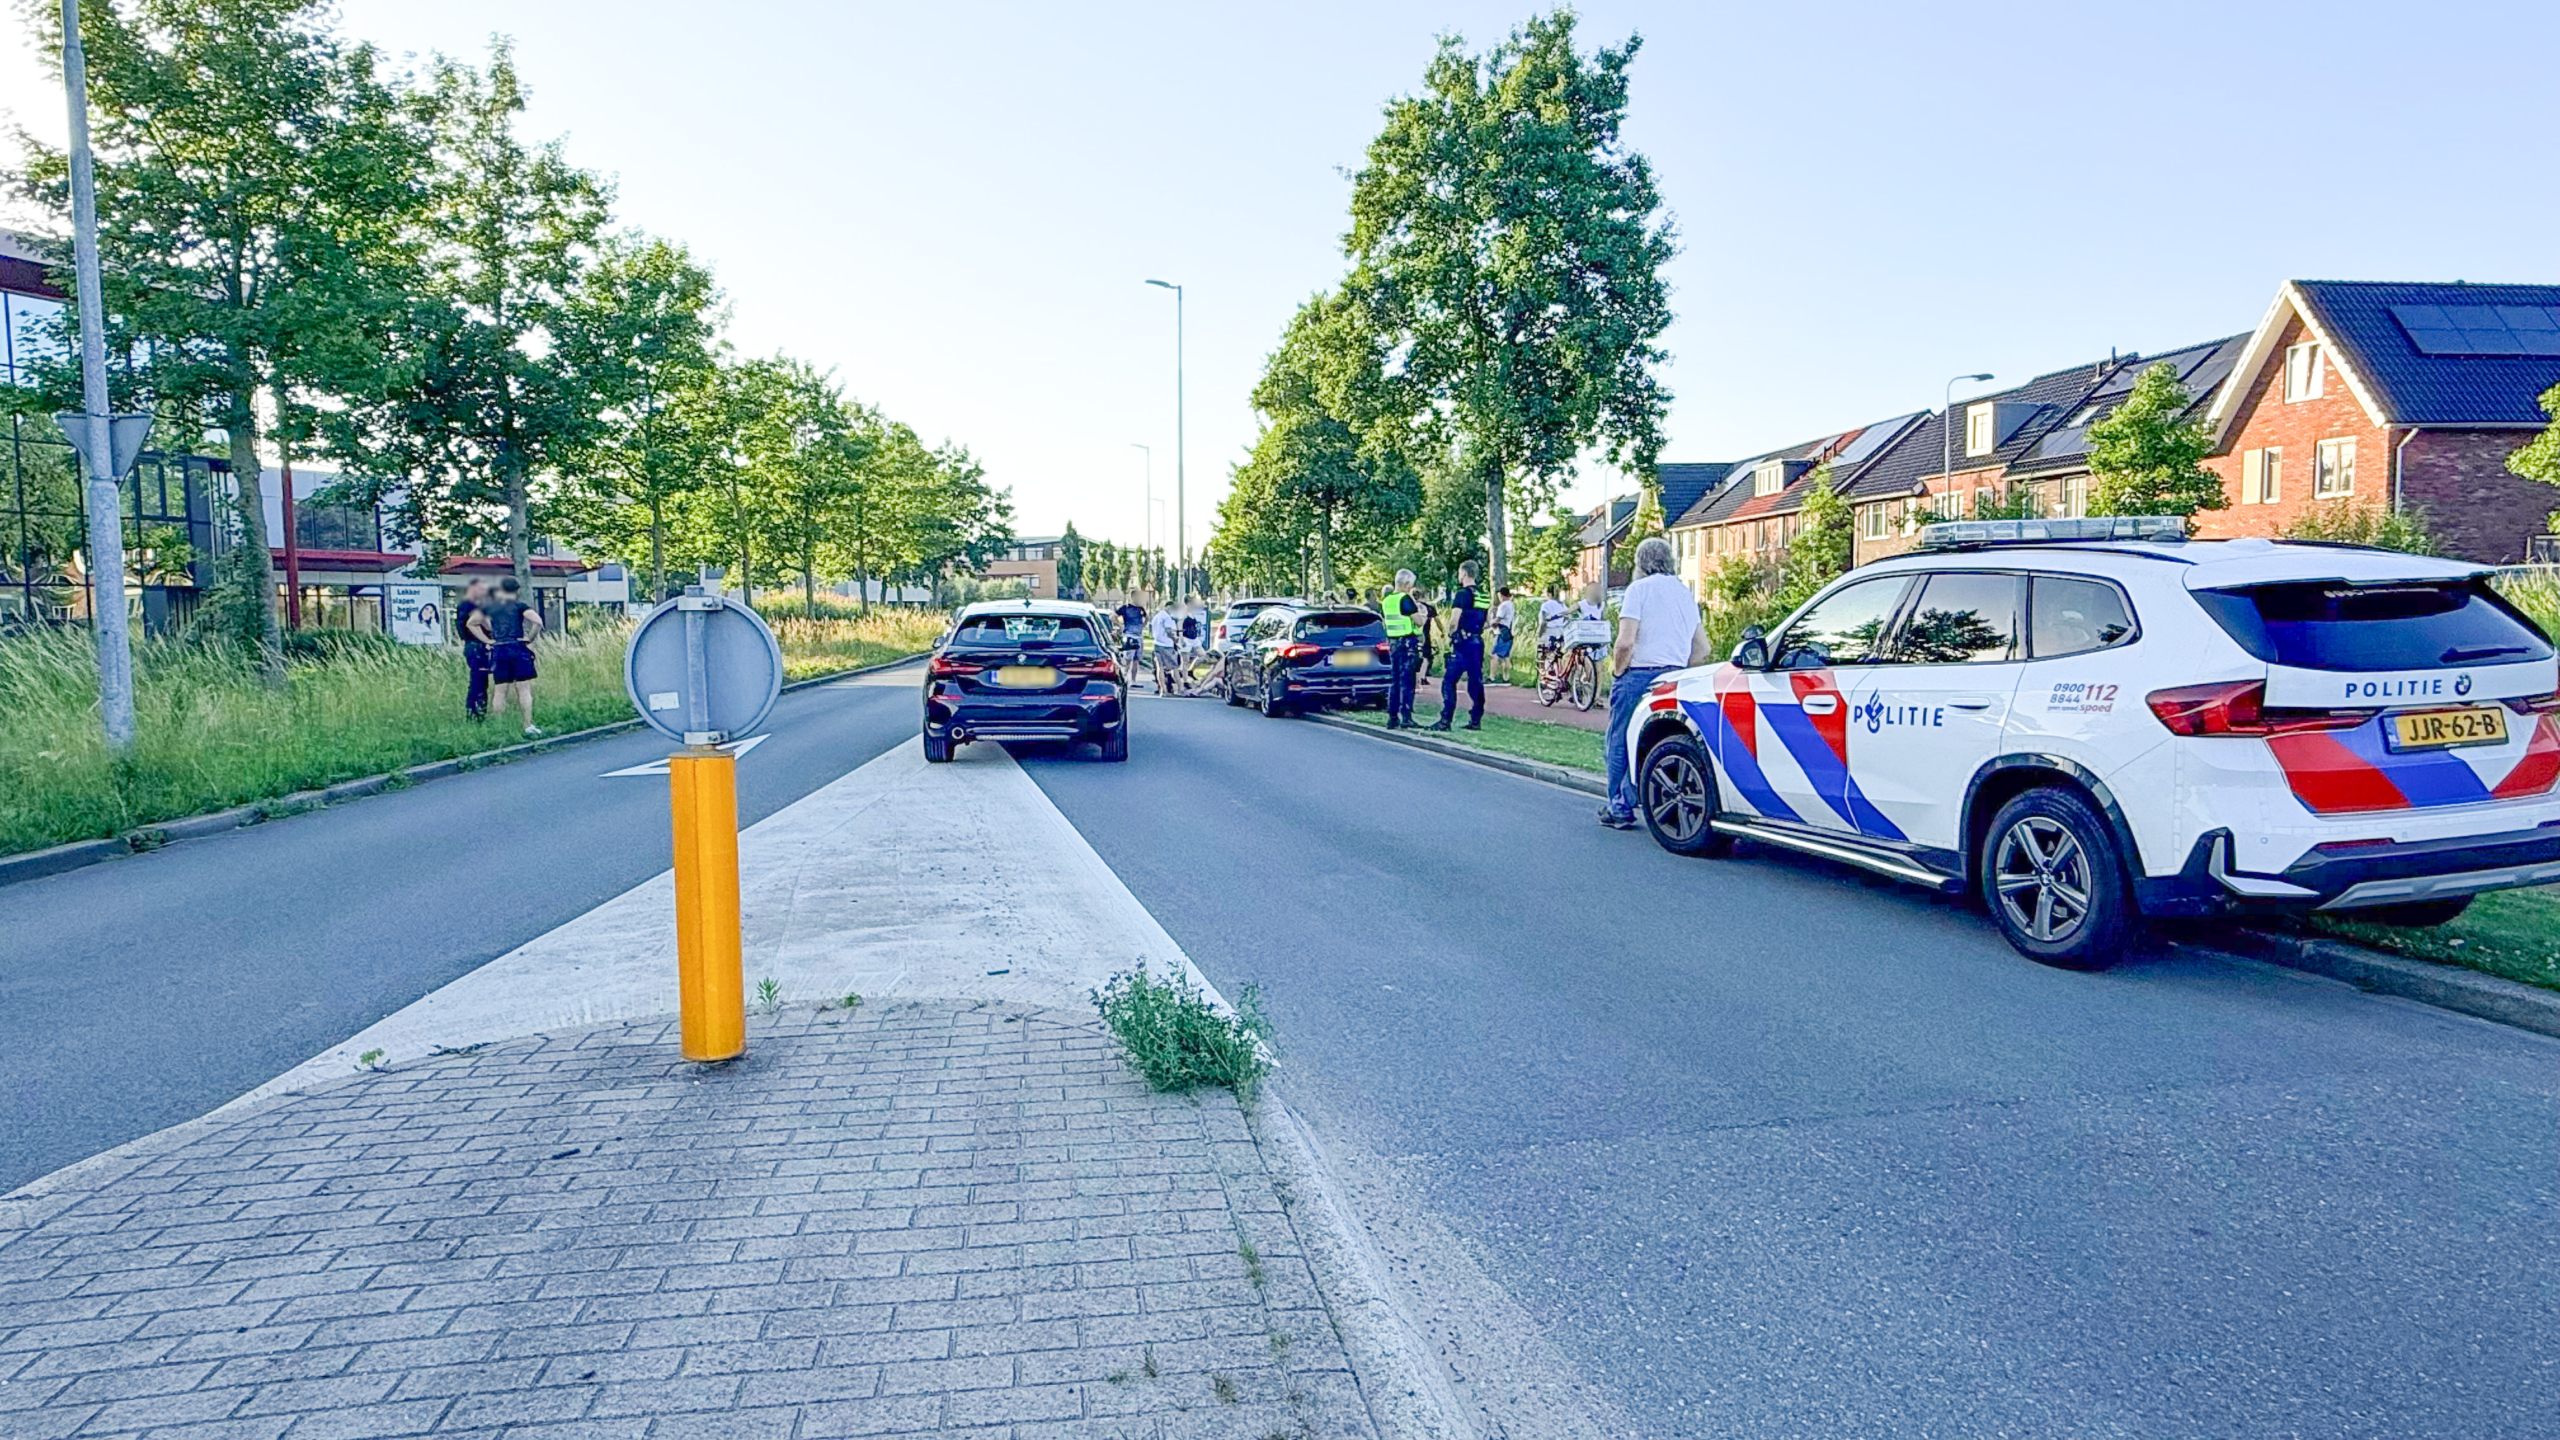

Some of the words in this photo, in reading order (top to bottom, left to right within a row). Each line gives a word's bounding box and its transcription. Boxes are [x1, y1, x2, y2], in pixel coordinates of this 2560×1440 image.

[2053, 683, 2085, 693] 0900
[2085, 684, 2119, 701] 112
[2345, 679, 2443, 698] POLITIE
[2049, 693, 2081, 704] 8844
[2079, 703, 2113, 714] spoed
[1854, 703, 1944, 733] POLITIE
[2409, 713, 2497, 742] JJR-62-B
